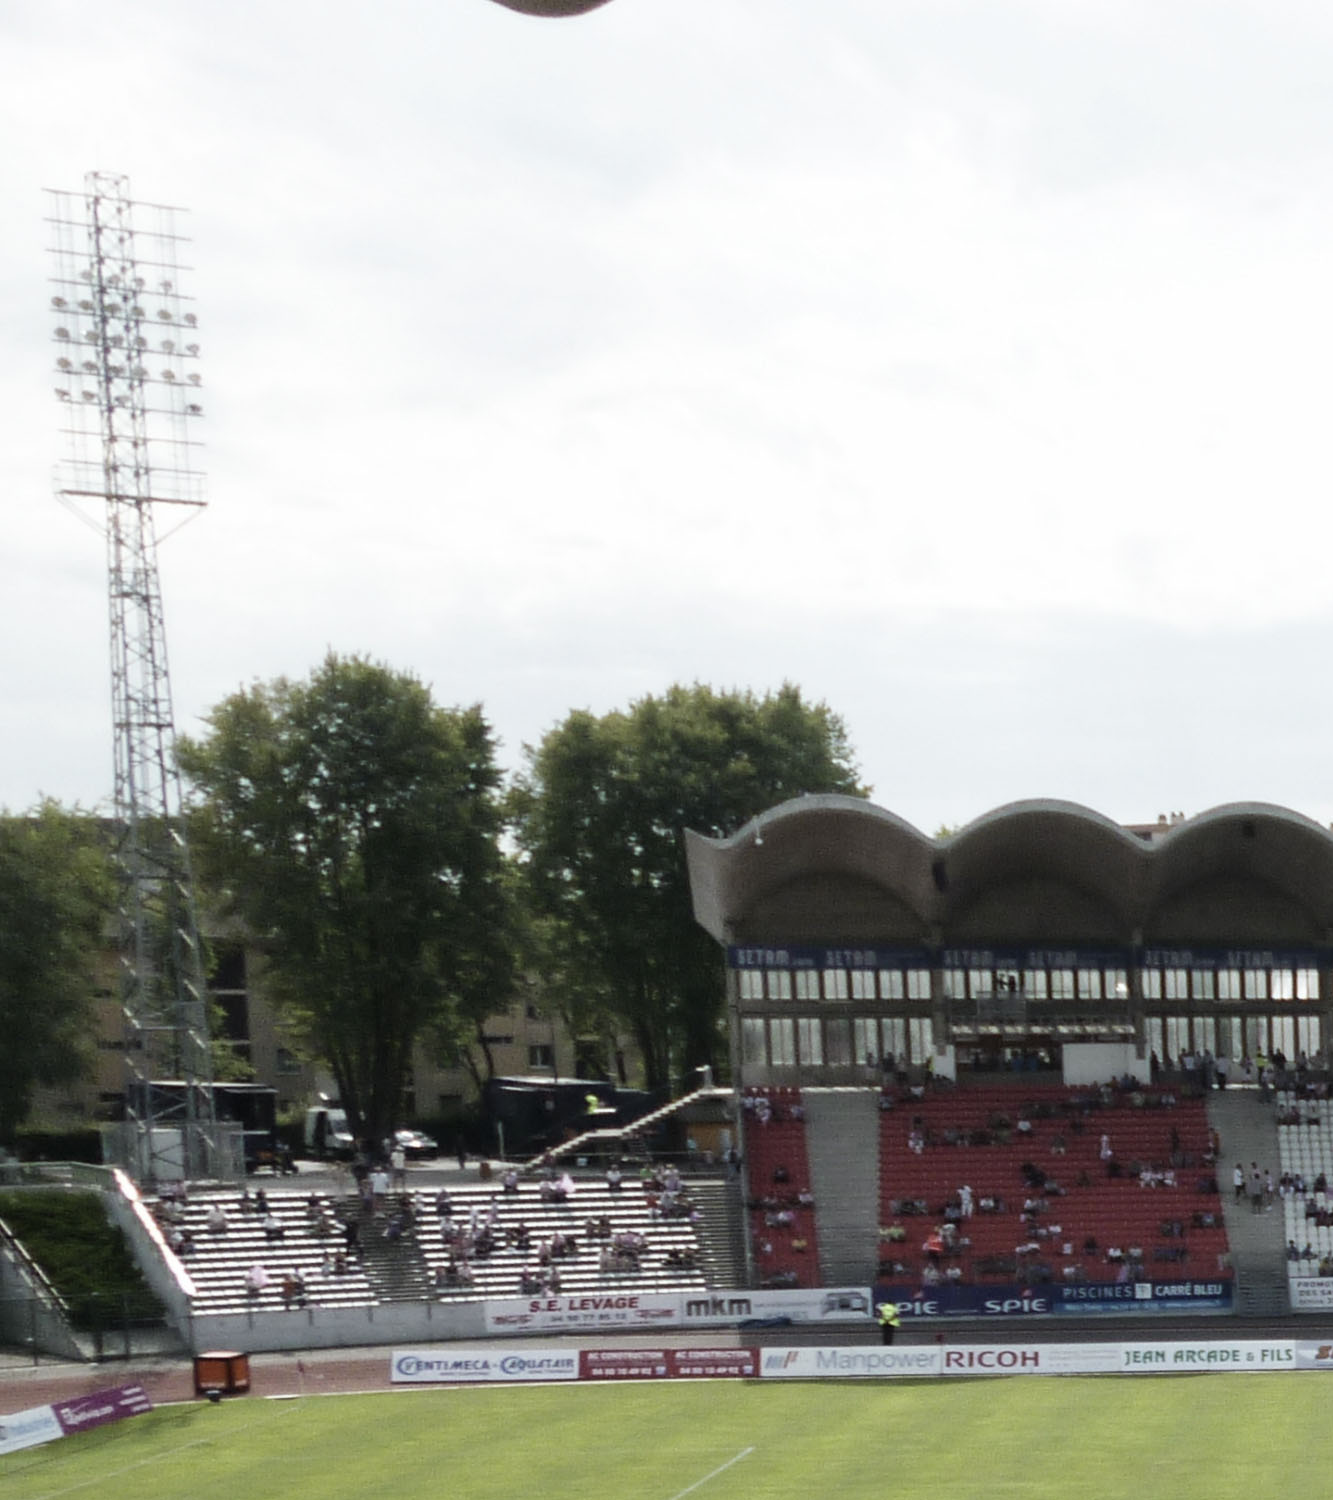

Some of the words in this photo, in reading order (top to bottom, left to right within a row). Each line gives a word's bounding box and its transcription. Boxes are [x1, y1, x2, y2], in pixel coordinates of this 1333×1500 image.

[1063, 1286, 1133, 1299] PISCINES
[1155, 1282, 1191, 1297] CARRÉ
[1193, 1284, 1223, 1296] BLEU
[529, 1299, 562, 1313] S.E.
[568, 1297, 640, 1311] LEVAGE
[686, 1296, 752, 1317] mkm
[984, 1298, 1047, 1313] SPIE
[505, 1358, 574, 1372] AQUATAIR
[817, 1350, 938, 1373] Manpower
[945, 1350, 1040, 1369] RICOH
[1124, 1350, 1166, 1365] JEAN
[1173, 1350, 1241, 1364] ARCADE
[1261, 1348, 1294, 1362] FILS
[404, 1358, 491, 1373] VENTIMECA
